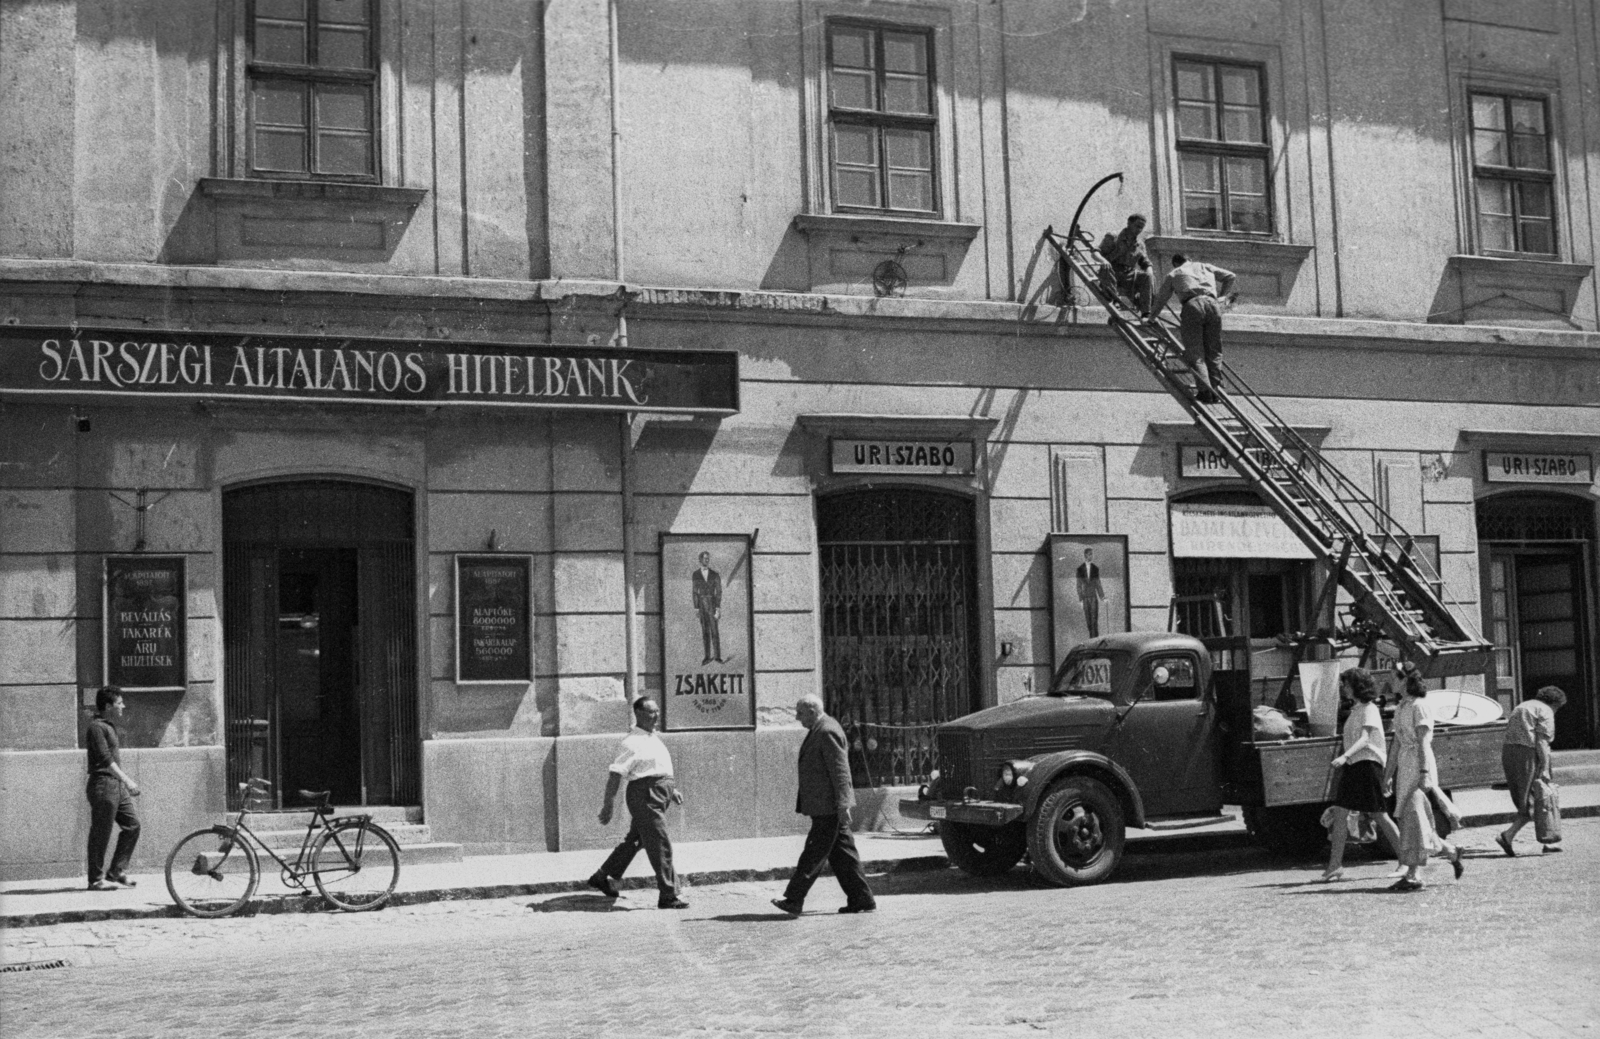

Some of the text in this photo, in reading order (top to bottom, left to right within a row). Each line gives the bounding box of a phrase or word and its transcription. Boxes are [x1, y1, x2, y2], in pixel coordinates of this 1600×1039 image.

[39, 330, 649, 405] SÁRSZEGI ÁLTALÁNOS HITELBANK
[1502, 456, 1530, 475] URI
[120, 608, 172, 622] BEVÁLTÁS
[122, 624, 172, 639] TAKARÉK
[135, 640, 157, 654] ÁRU
[675, 673, 745, 696] ZSAKETT
